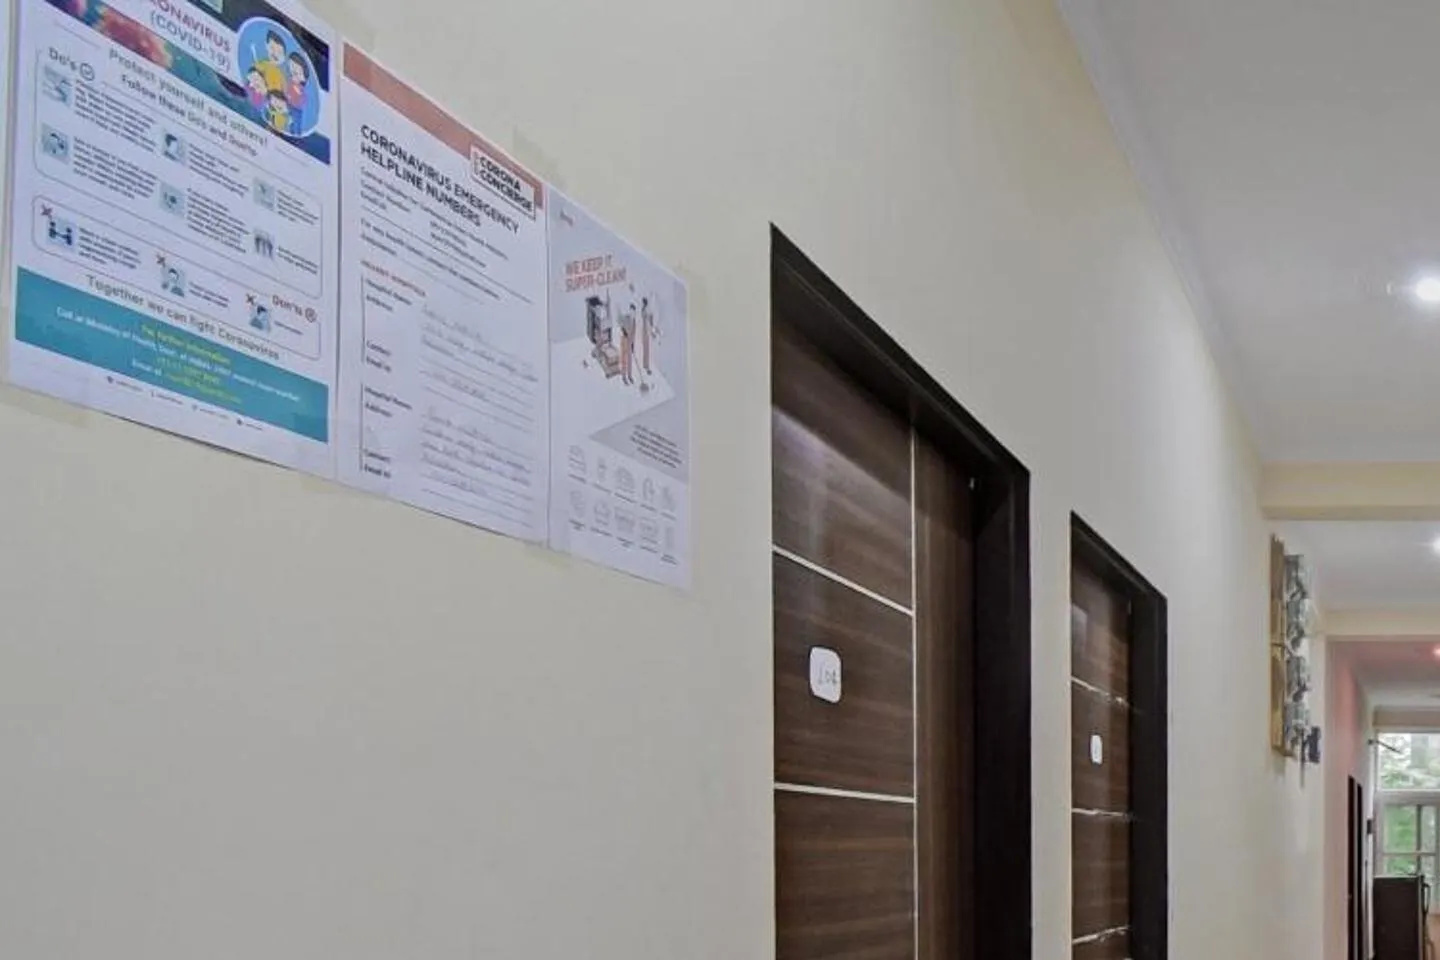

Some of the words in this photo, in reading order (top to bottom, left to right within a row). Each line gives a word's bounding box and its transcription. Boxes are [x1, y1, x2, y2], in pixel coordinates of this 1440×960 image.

[151, 10, 231, 73] (COVID-19)
[152, 0, 231, 53] ONAVIRUS
[360, 124, 452, 191] CORONAVIRUS
[454, 183, 520, 234] EMERGENCY
[360, 141, 423, 192] HELPLINE
[425, 182, 481, 228] NUMBERS
[480, 156, 521, 192] CORONA
[480, 169, 532, 212] CONCIERGE
[582, 256, 604, 273] KEEP
